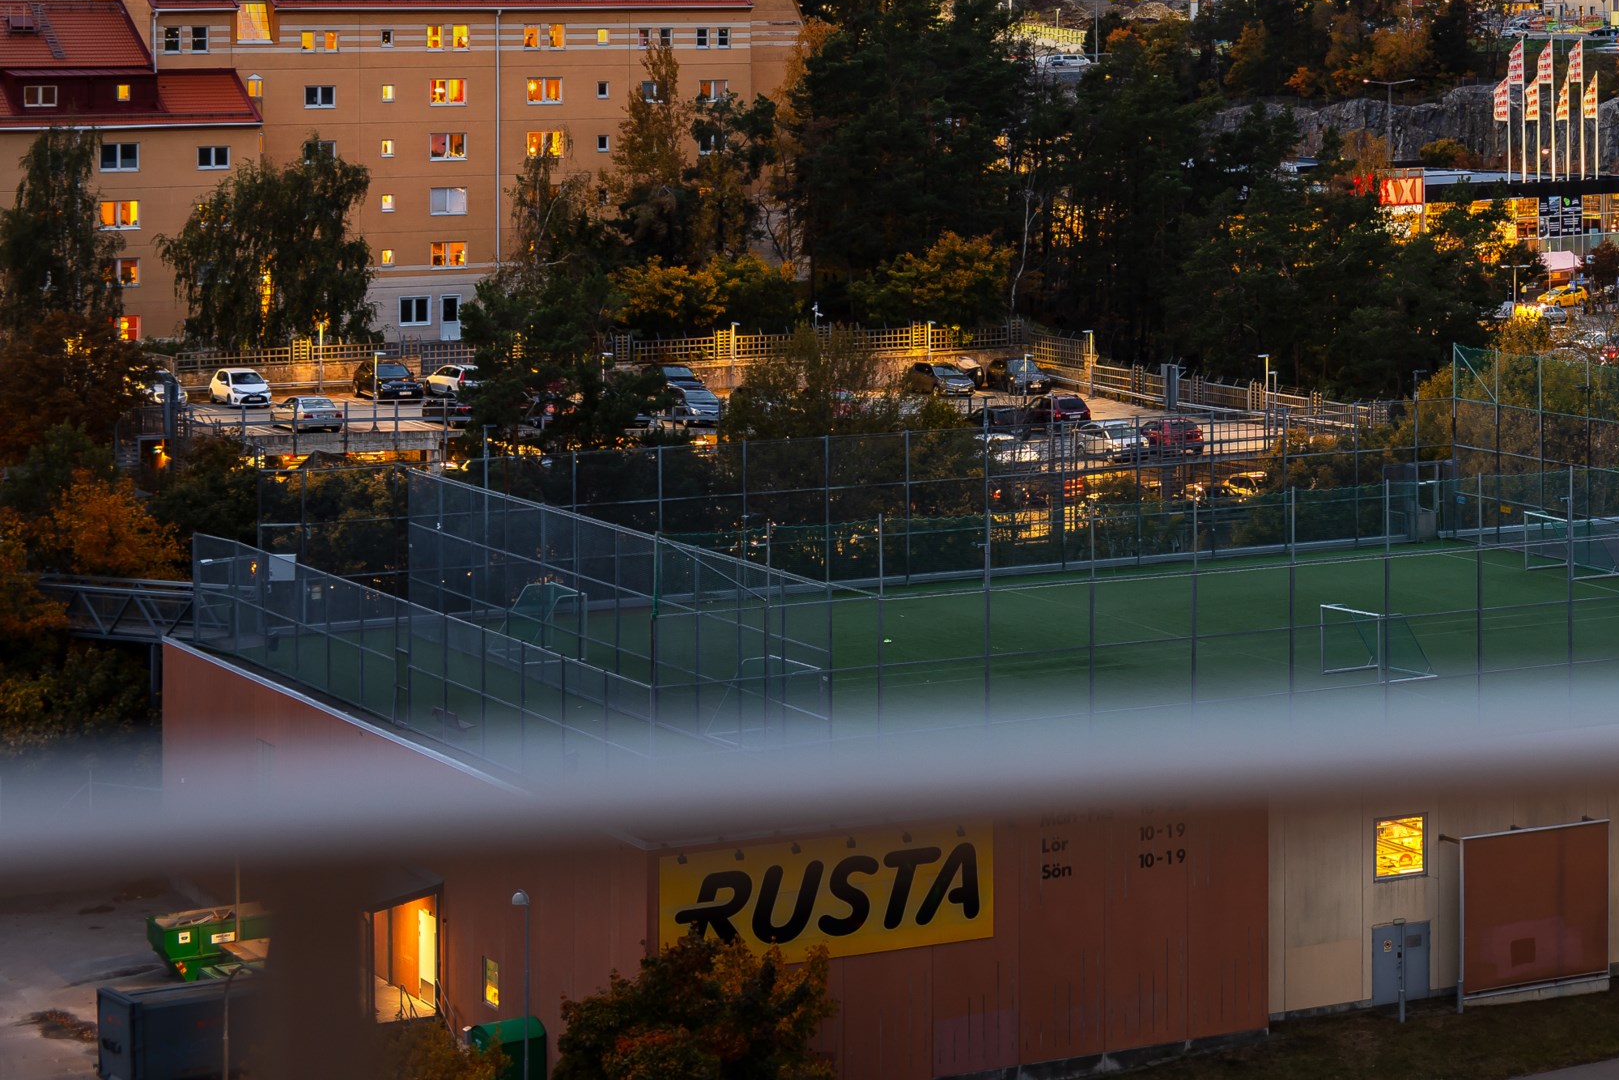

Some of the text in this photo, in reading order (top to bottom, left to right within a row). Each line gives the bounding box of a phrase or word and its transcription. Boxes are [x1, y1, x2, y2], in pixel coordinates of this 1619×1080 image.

[1380, 178, 1423, 205] AXI
[1041, 822, 1186, 853] Lör 10-19
[1041, 848, 1187, 880] Sön 10-19
[675, 842, 980, 944] RUSTA
